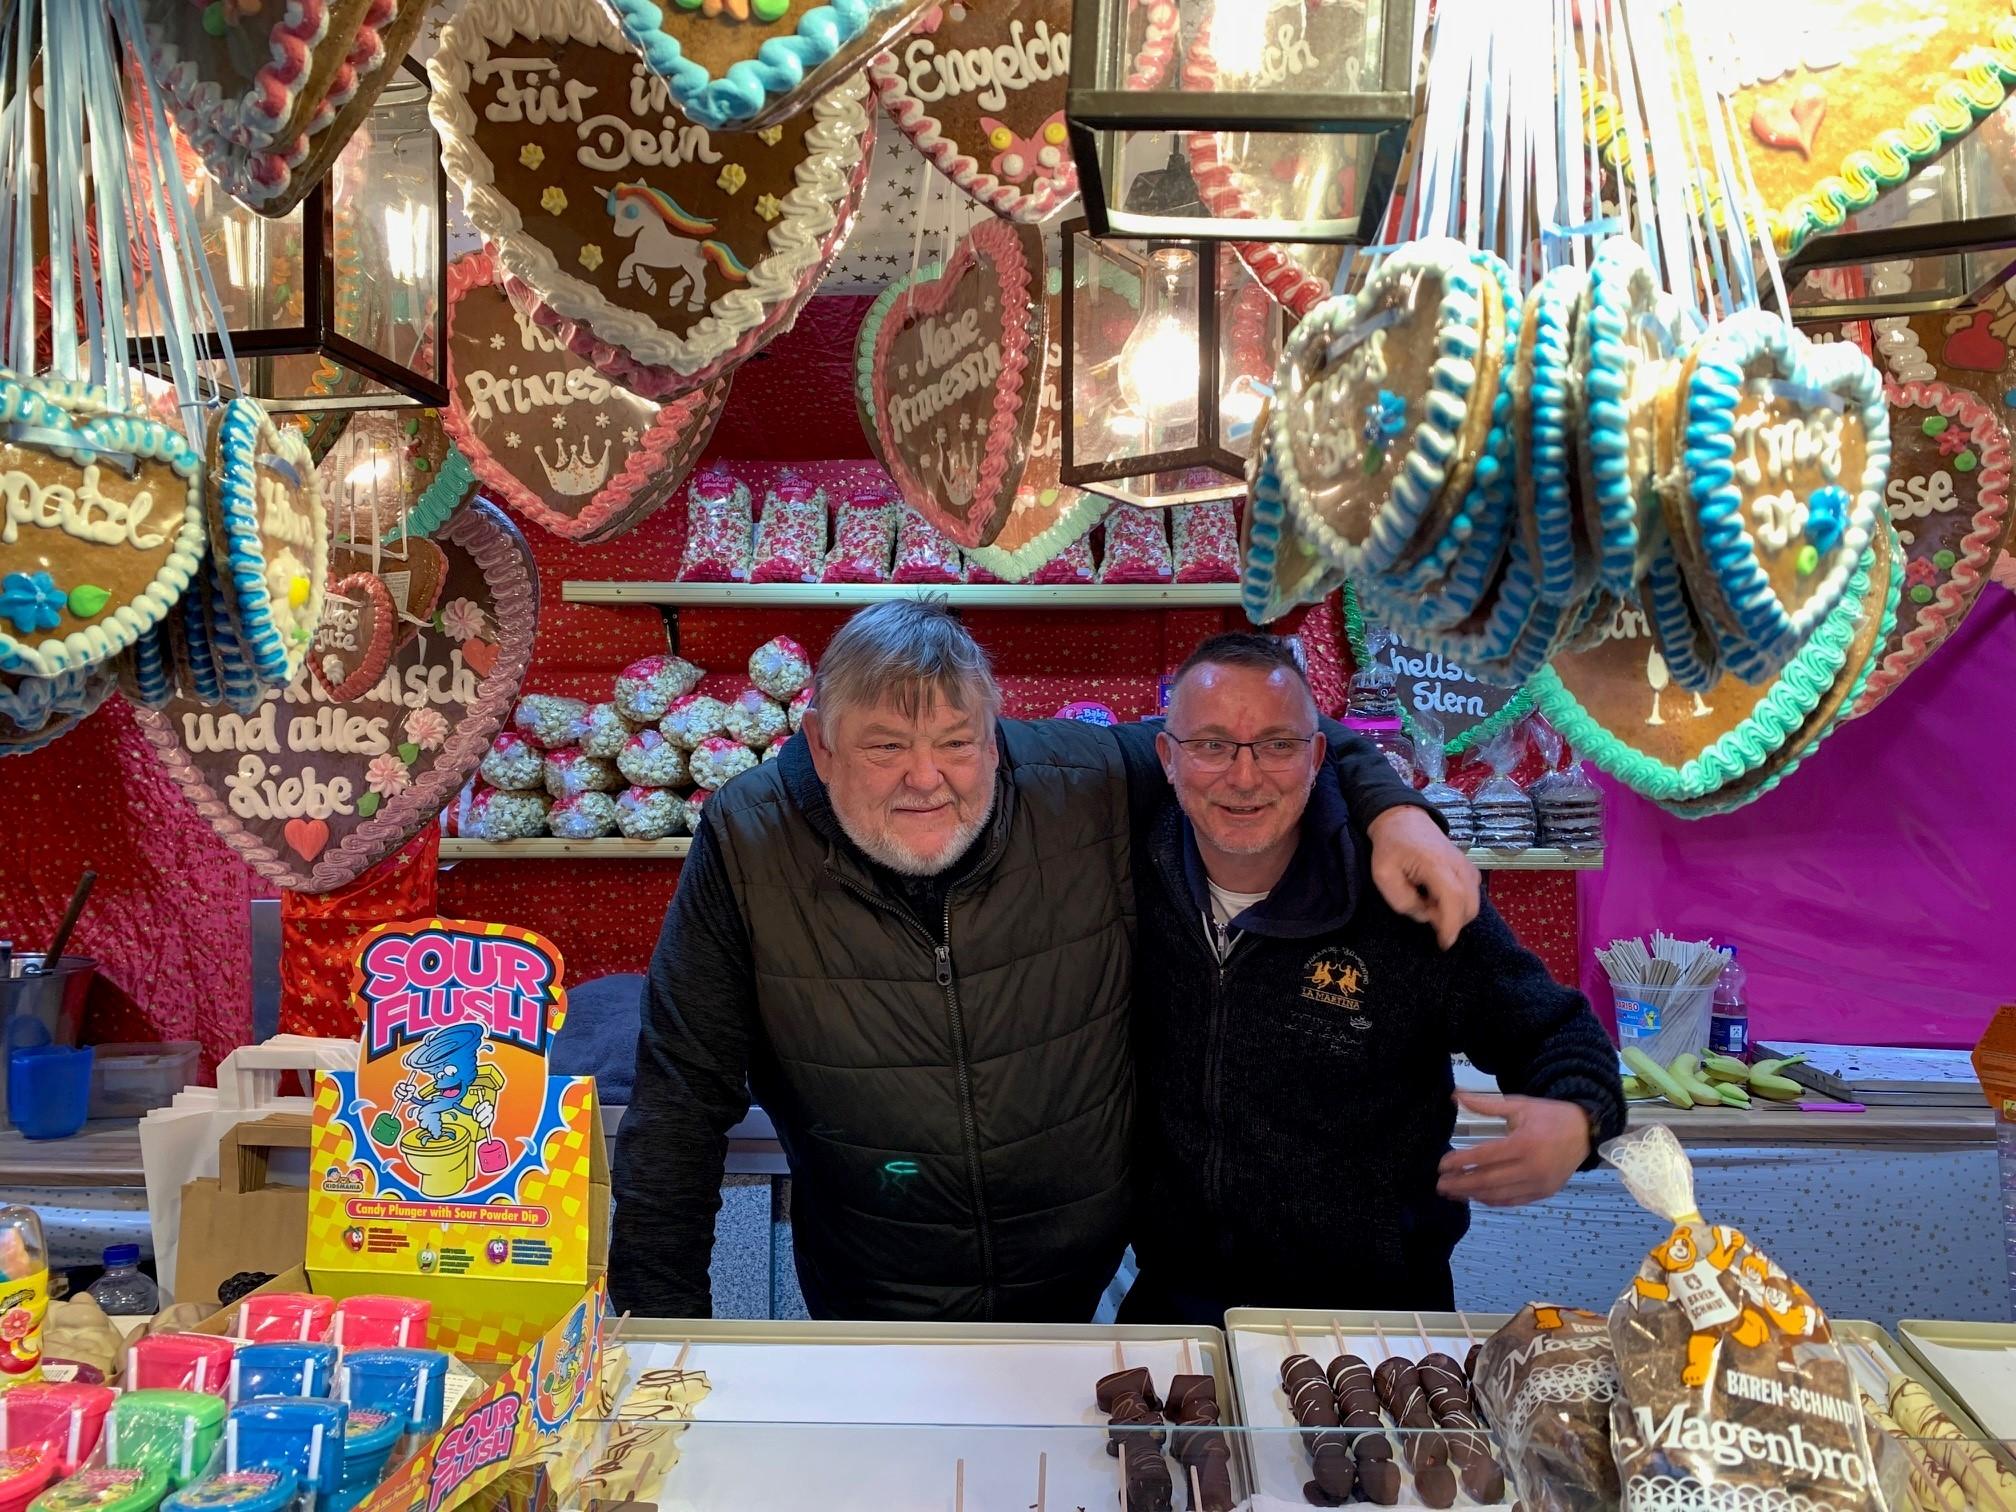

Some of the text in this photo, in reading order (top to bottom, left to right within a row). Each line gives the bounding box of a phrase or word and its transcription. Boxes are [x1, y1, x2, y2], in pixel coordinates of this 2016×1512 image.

[472, 57, 598, 125] Für
[577, 114, 723, 172] Dein
[182, 702, 391, 756] und alles
[1412, 681, 1489, 718] Stern
[224, 753, 355, 820] Liebe
[366, 935, 549, 998] SOUR
[373, 987, 541, 1051] FLUSH
[1316, 991, 1360, 1009] MARTINA
[325, 1182, 361, 1191] KIDSMANIA
[355, 1202, 539, 1224] Candy Plunger with Sour Powder Dip
[435, 1395, 520, 1464] SOUR
[427, 1428, 513, 1512] FLUSH
